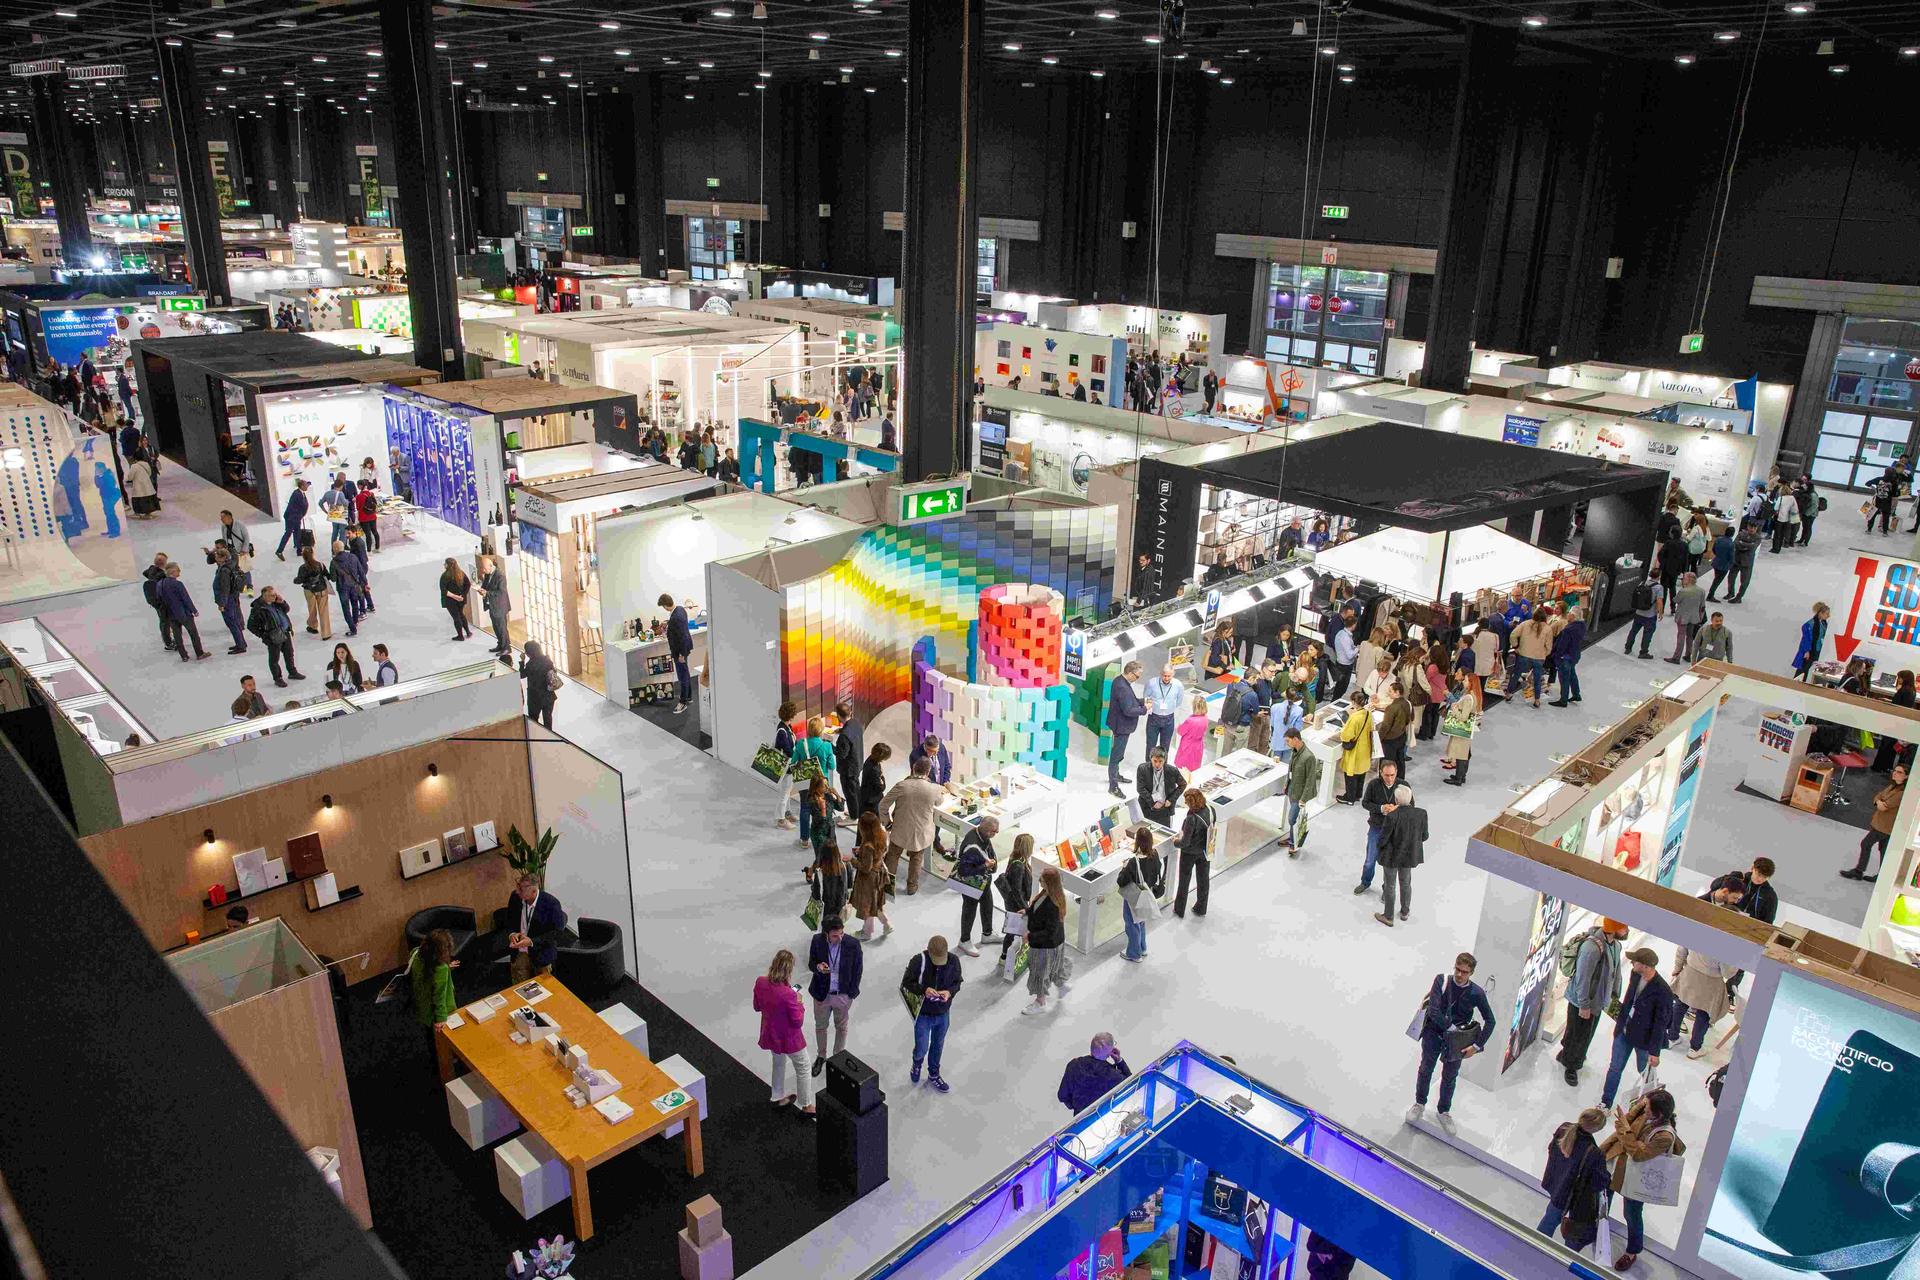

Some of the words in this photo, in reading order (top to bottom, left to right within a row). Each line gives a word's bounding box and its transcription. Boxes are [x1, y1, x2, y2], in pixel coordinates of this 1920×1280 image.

[1324, 253, 1335, 263] 10
[1309, 298, 1321, 306] STOP
[1329, 301, 1341, 309] STOP
[48, 315, 80, 323] Unlocking
[68, 329, 102, 337] sustainable
[282, 413, 320, 425] ICMA
[1154, 498, 1168, 596] MAINETTI
[1760, 728, 1792, 753] TYPE
[1791, 1034, 1854, 1067] TOSCANO
[1792, 1025, 1894, 1073] SACCHETTIFICIO
